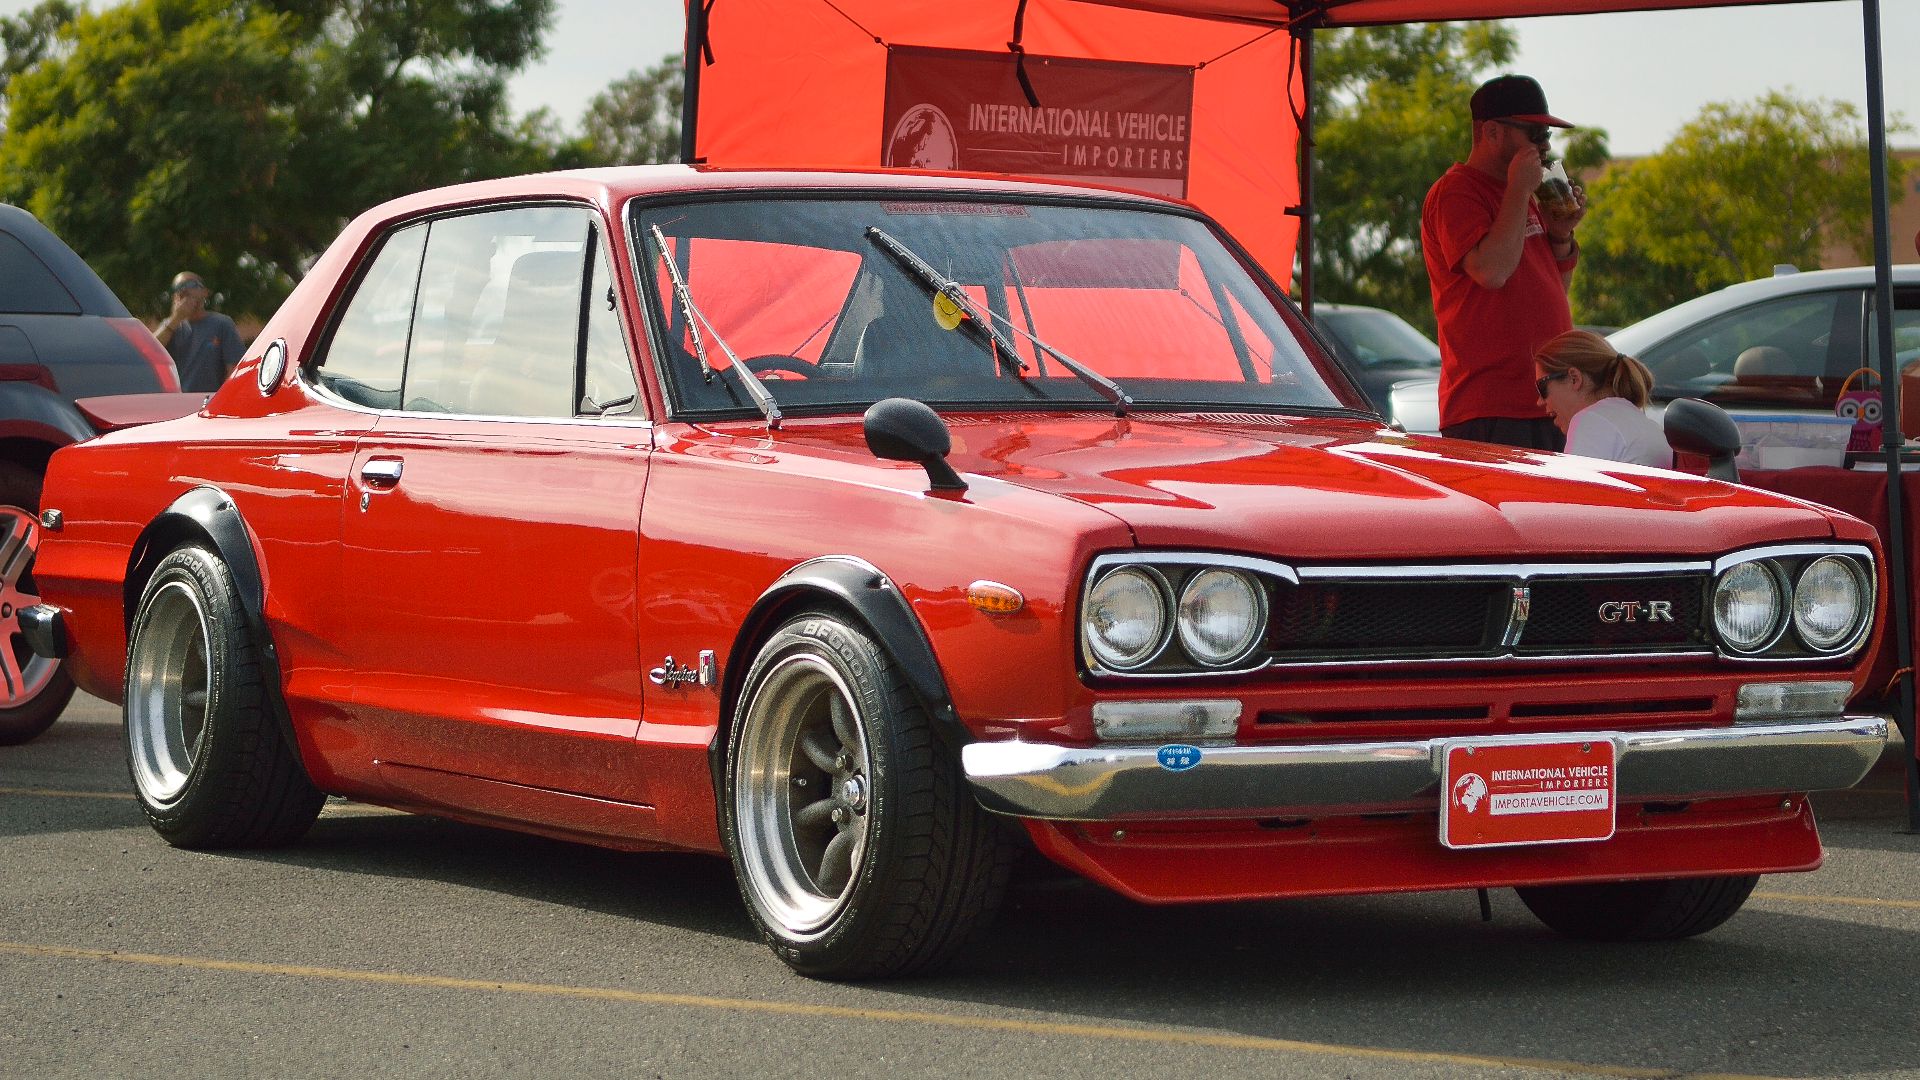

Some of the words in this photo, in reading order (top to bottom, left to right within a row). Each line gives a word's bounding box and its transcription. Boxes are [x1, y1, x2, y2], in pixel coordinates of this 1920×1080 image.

[969, 103, 1111, 138] INTERNATIONAL
[1117, 111, 1185, 142] VEHICLE
[1063, 144, 1184, 170] IMPORTERS
[1599, 600, 1674, 623] GT-R
[1491, 767, 1566, 781] INTERNATIONAL
[1568, 765, 1608, 777] VEHICLE
[1540, 778, 1608, 789] IMPORTERS
[1495, 794, 1603, 809] IMPORTAVEHICLE.COM
